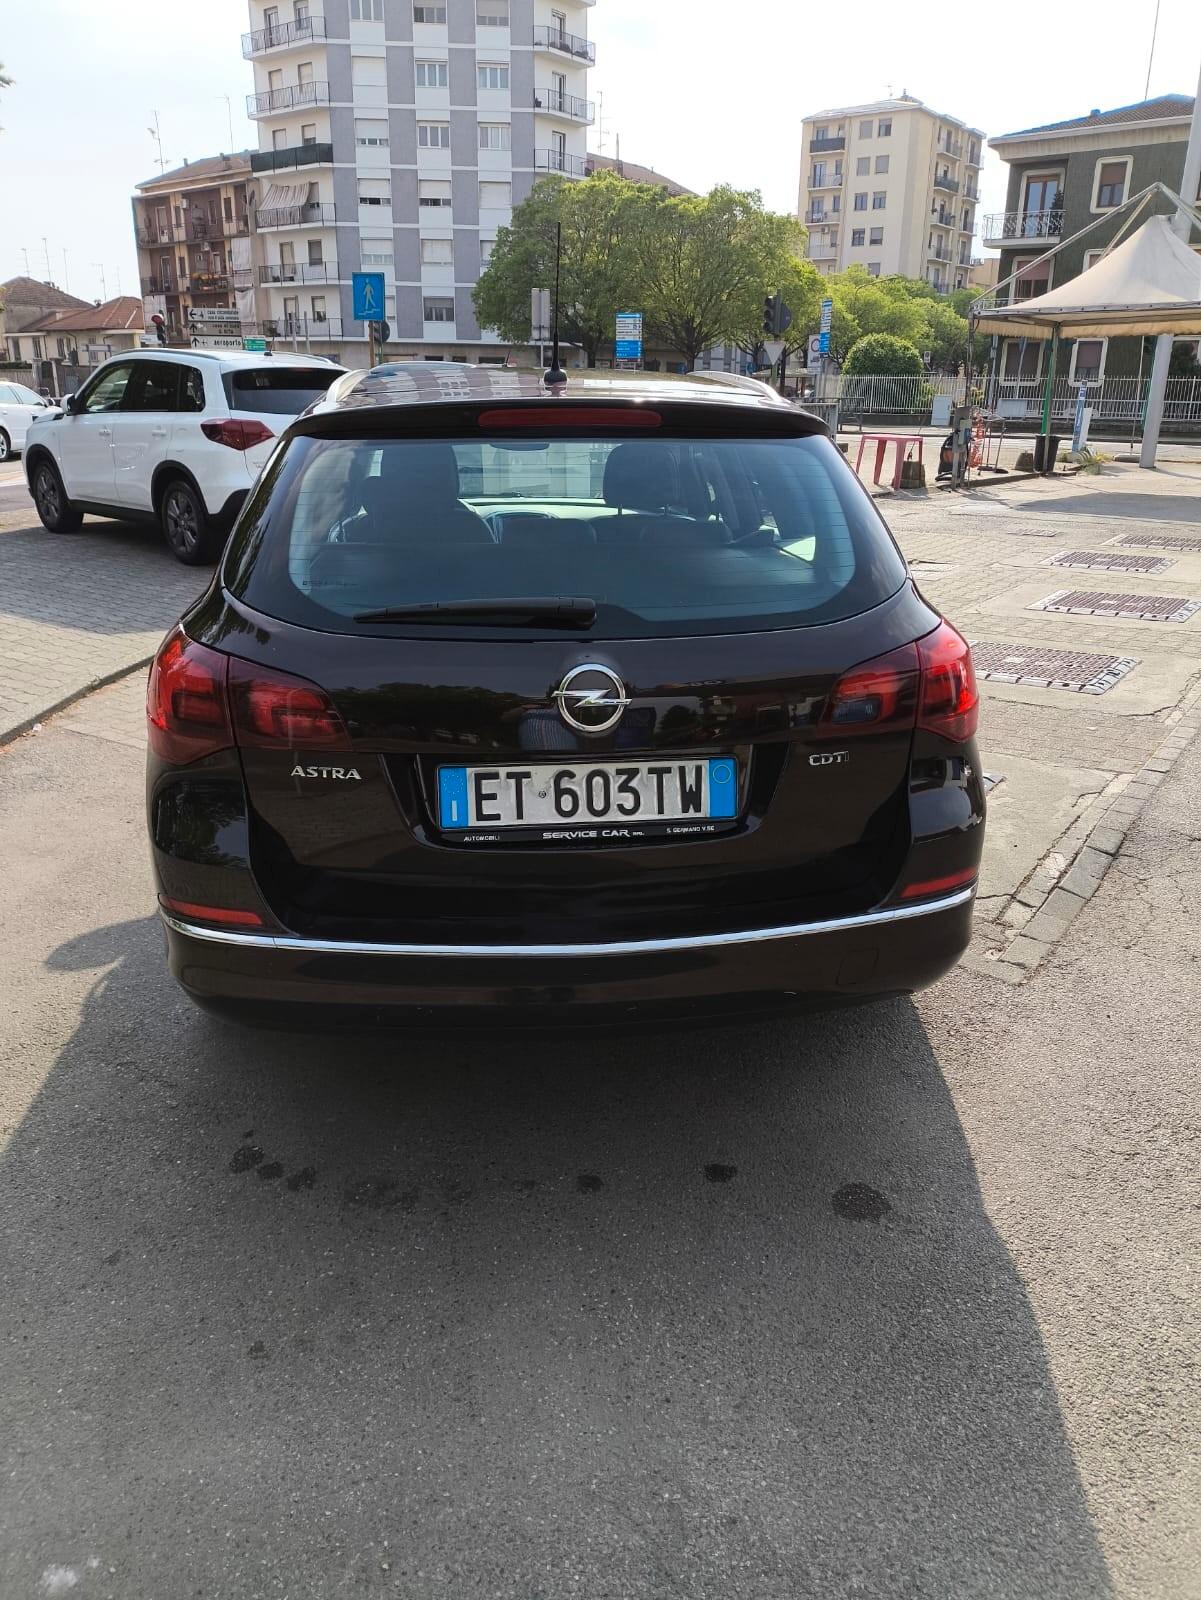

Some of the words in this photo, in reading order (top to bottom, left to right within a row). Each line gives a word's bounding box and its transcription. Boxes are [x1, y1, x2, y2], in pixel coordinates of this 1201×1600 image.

[214, 339, 241, 347] aeroporto
[290, 765, 362, 780] ASTRA
[474, 771, 531, 822] ET
[553, 765, 703, 818] 603TW
[542, 830, 598, 839] SERVICE
[602, 829, 631, 837] CAR
